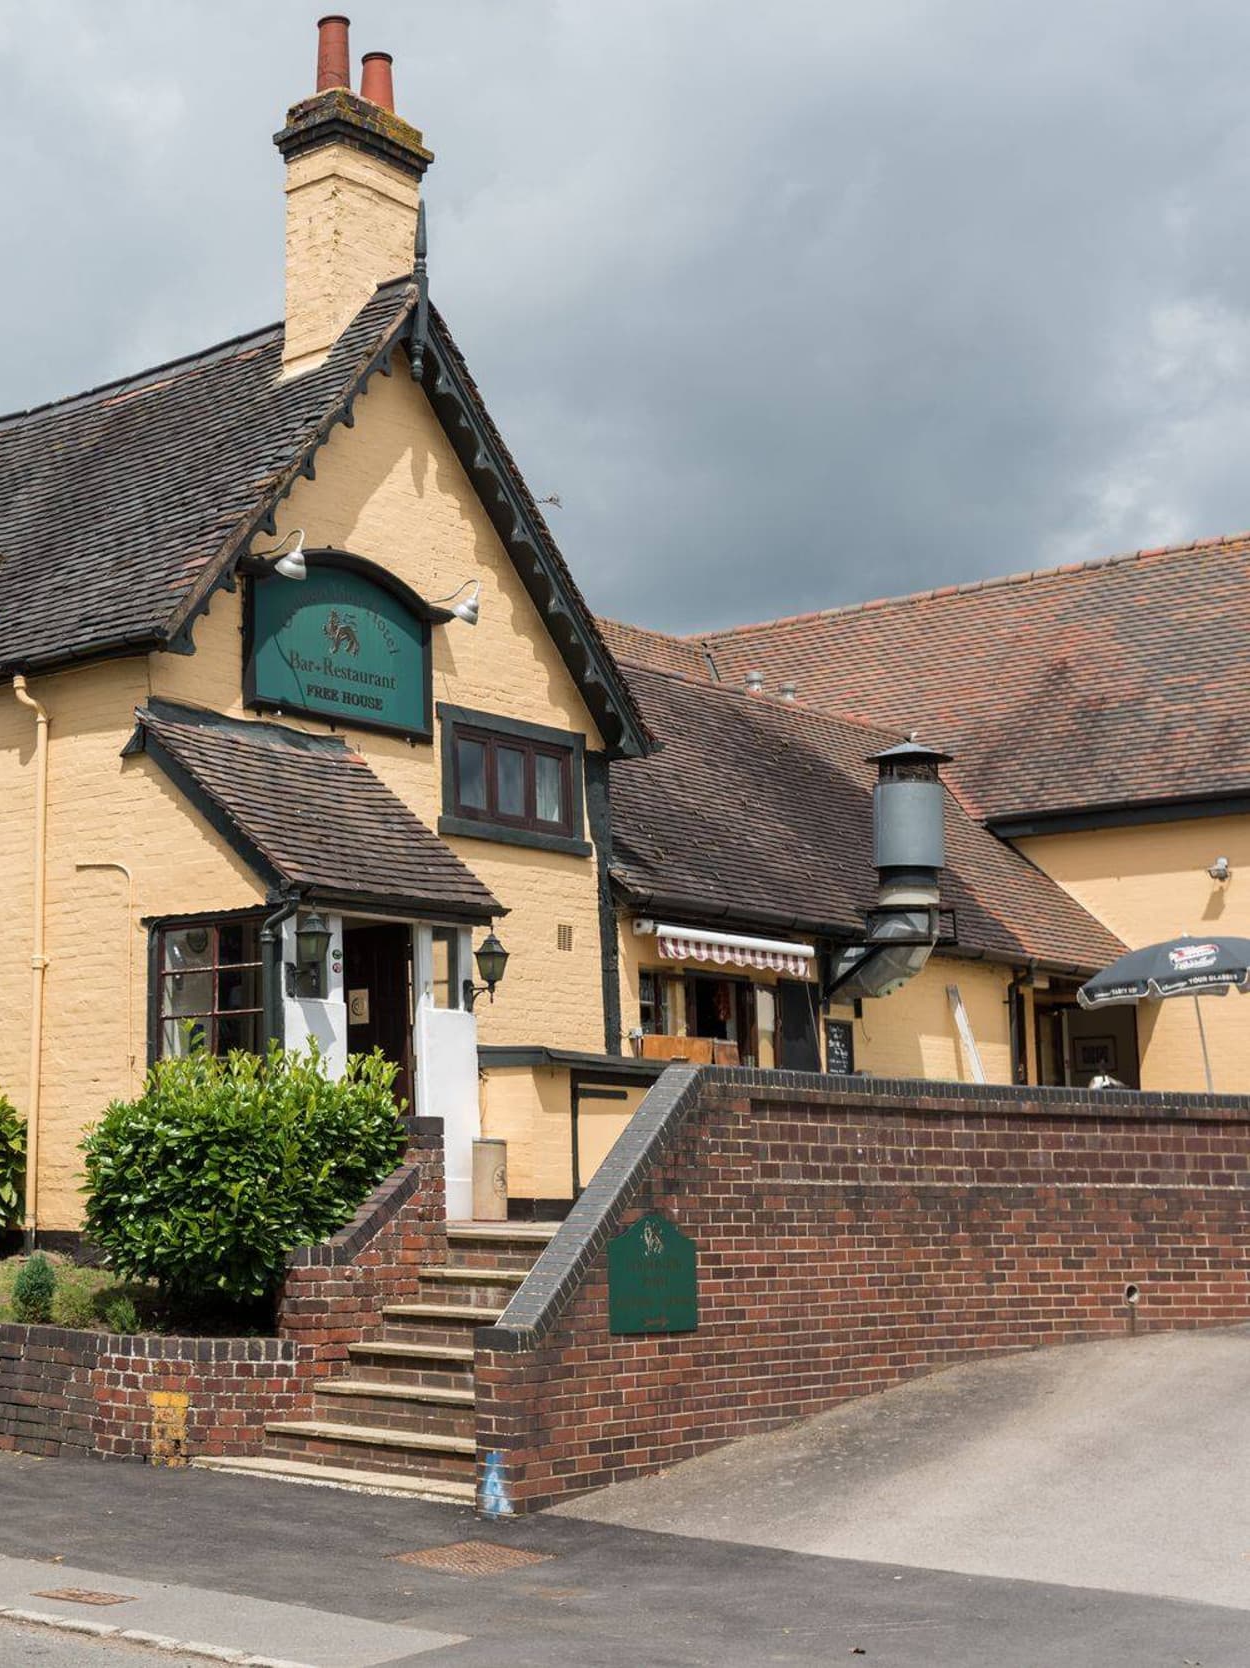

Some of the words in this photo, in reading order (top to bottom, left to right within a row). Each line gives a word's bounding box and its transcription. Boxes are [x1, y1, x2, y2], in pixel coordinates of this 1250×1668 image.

[306, 684, 340, 703] FREE
[342, 690, 384, 711] HOUSE
[1188, 975, 1208, 985] YOUR
